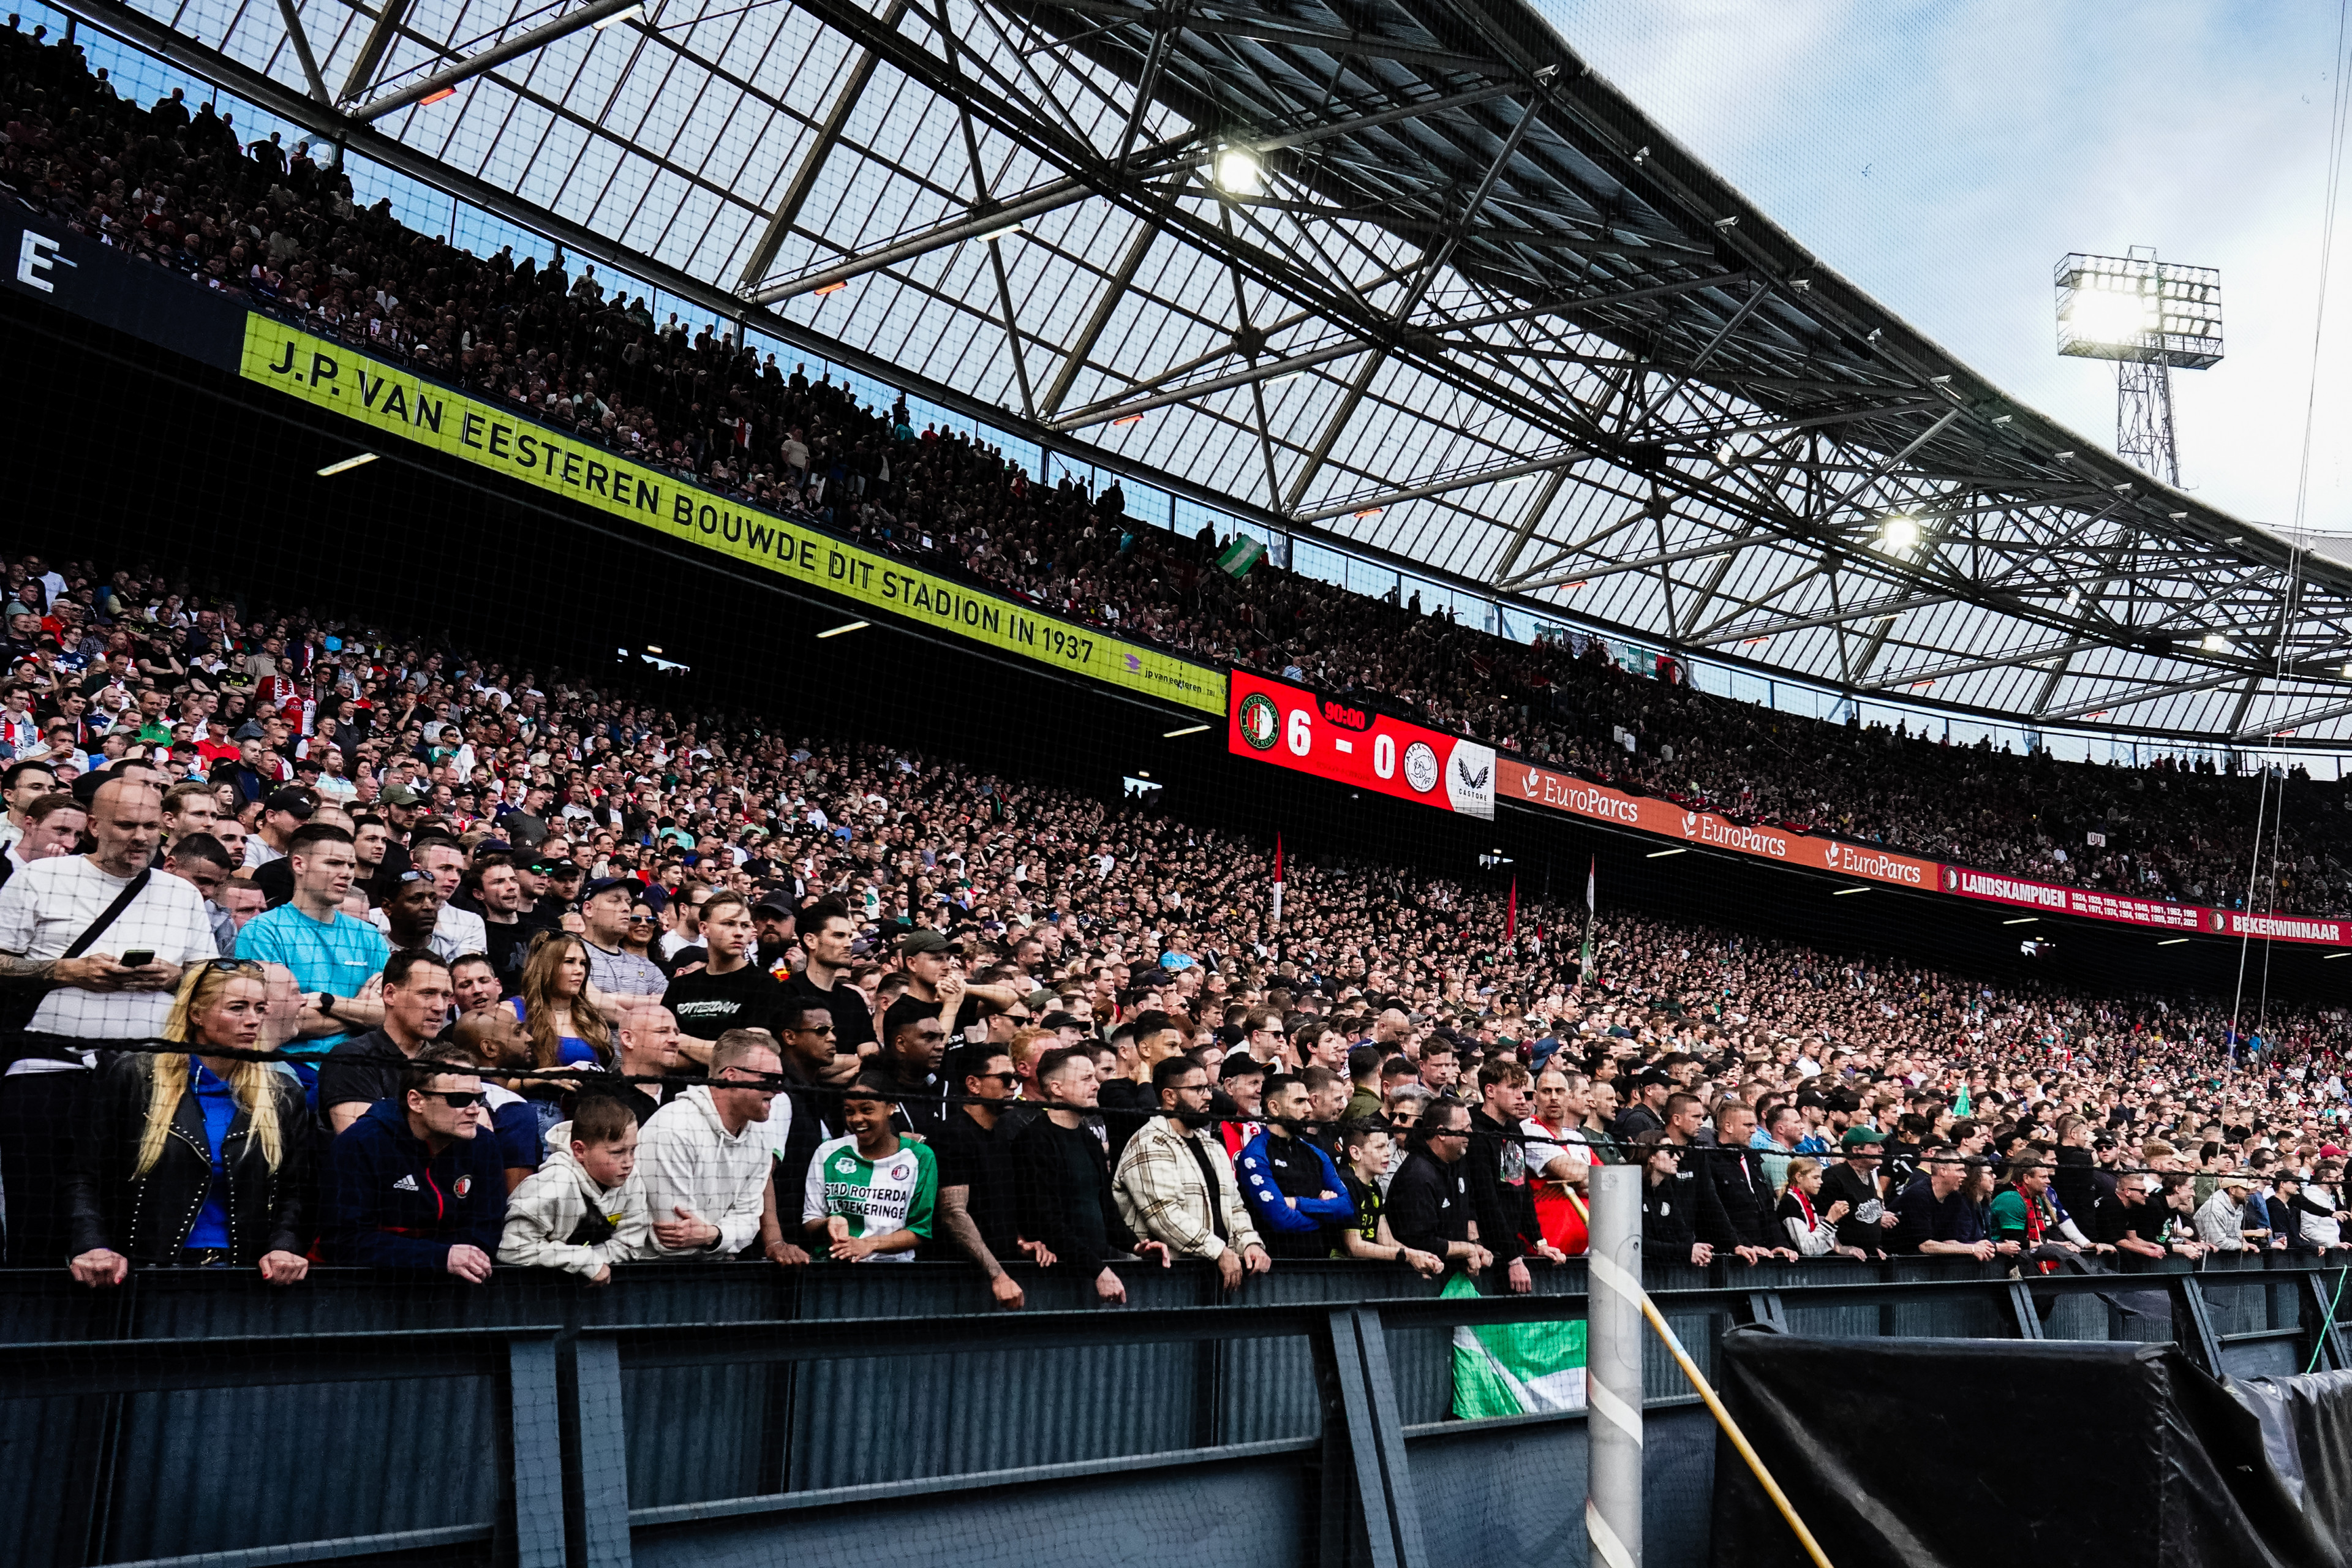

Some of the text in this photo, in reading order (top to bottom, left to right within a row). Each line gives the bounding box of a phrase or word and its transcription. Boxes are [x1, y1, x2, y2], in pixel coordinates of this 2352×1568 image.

[17, 229, 60, 293] E
[269, 341, 1093, 663] J.P. VAN EESTEREN BOUWDE DIT STADION IN 1937
[1154, 673, 1167, 681] van
[1324, 701, 1365, 729] 90:00
[1287, 709, 1311, 756] 6
[1374, 734, 1395, 779] 0
[1406, 744, 1421, 762] AJAX
[1459, 788, 1487, 802] CASTORE
[1544, 776, 1920, 883] EuroParcs EuroParcs EuroParcs
[1962, 873, 2066, 908] LANDSKAMPIOEN
[2233, 915, 2339, 941] BEKERWINNAAR
[393, 1183, 419, 1191] adidas
[824, 1183, 907, 1202] STAD ROTTERDA
